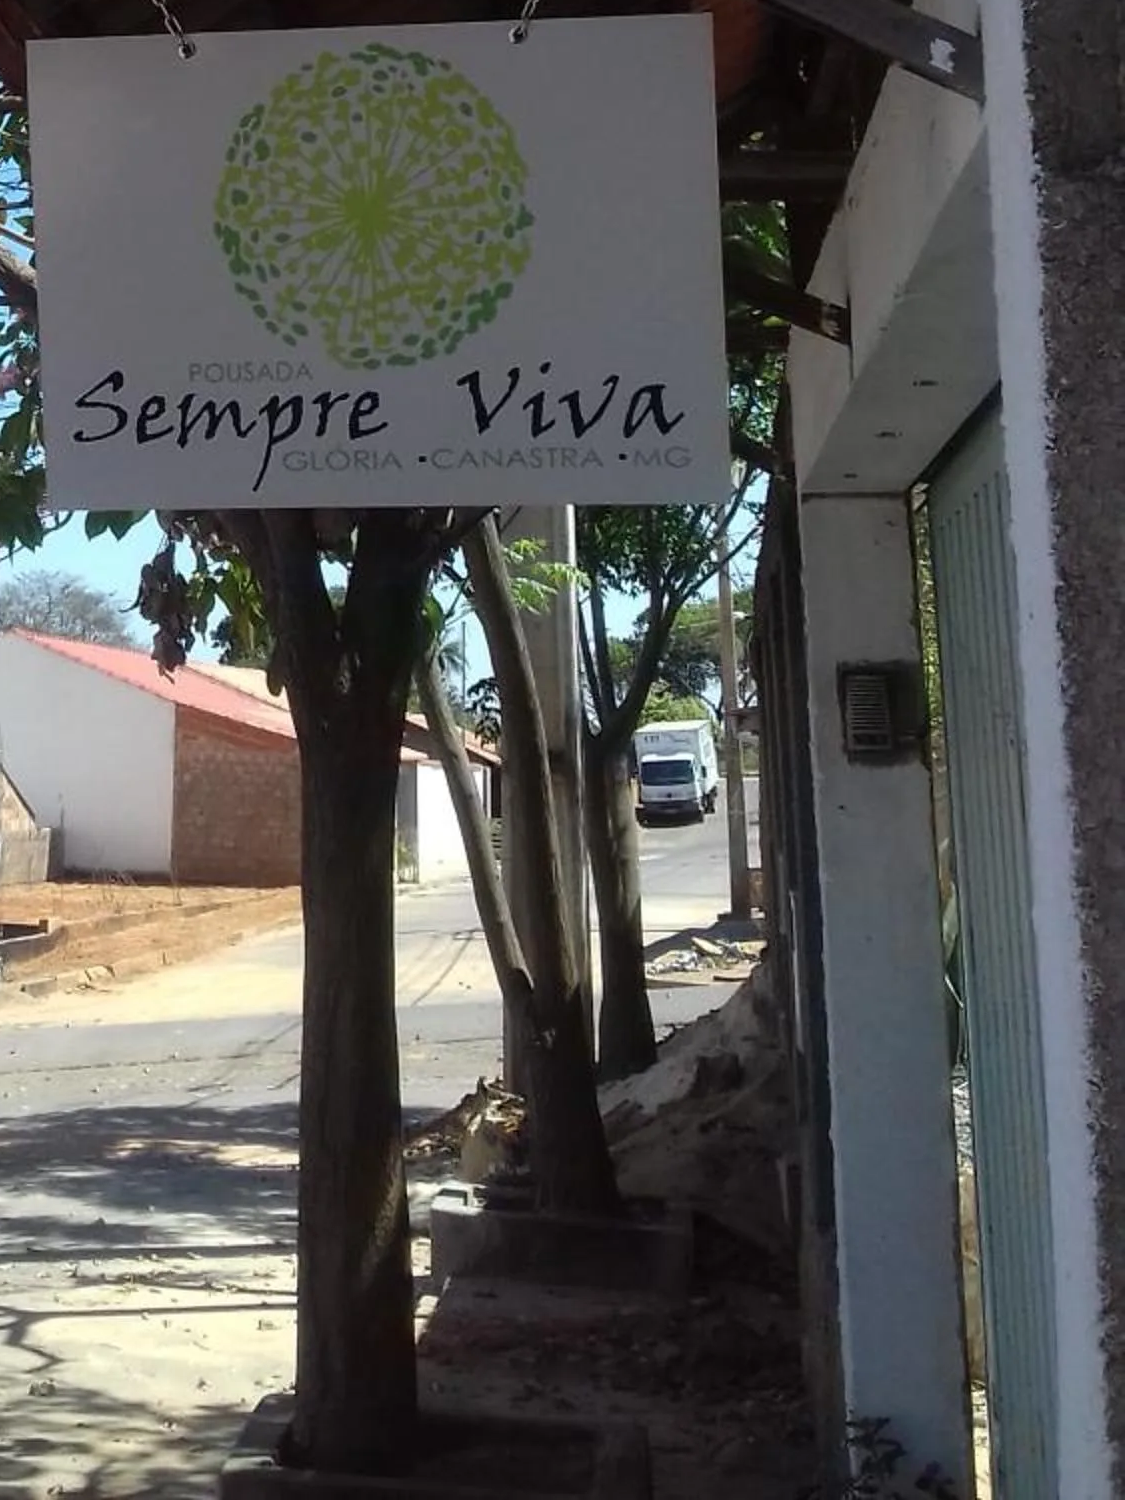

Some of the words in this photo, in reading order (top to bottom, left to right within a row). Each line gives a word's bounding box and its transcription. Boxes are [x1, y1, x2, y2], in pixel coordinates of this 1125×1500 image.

[188, 361, 314, 384] POUSADA
[72, 370, 388, 492] Sempre
[456, 360, 685, 439] Viva
